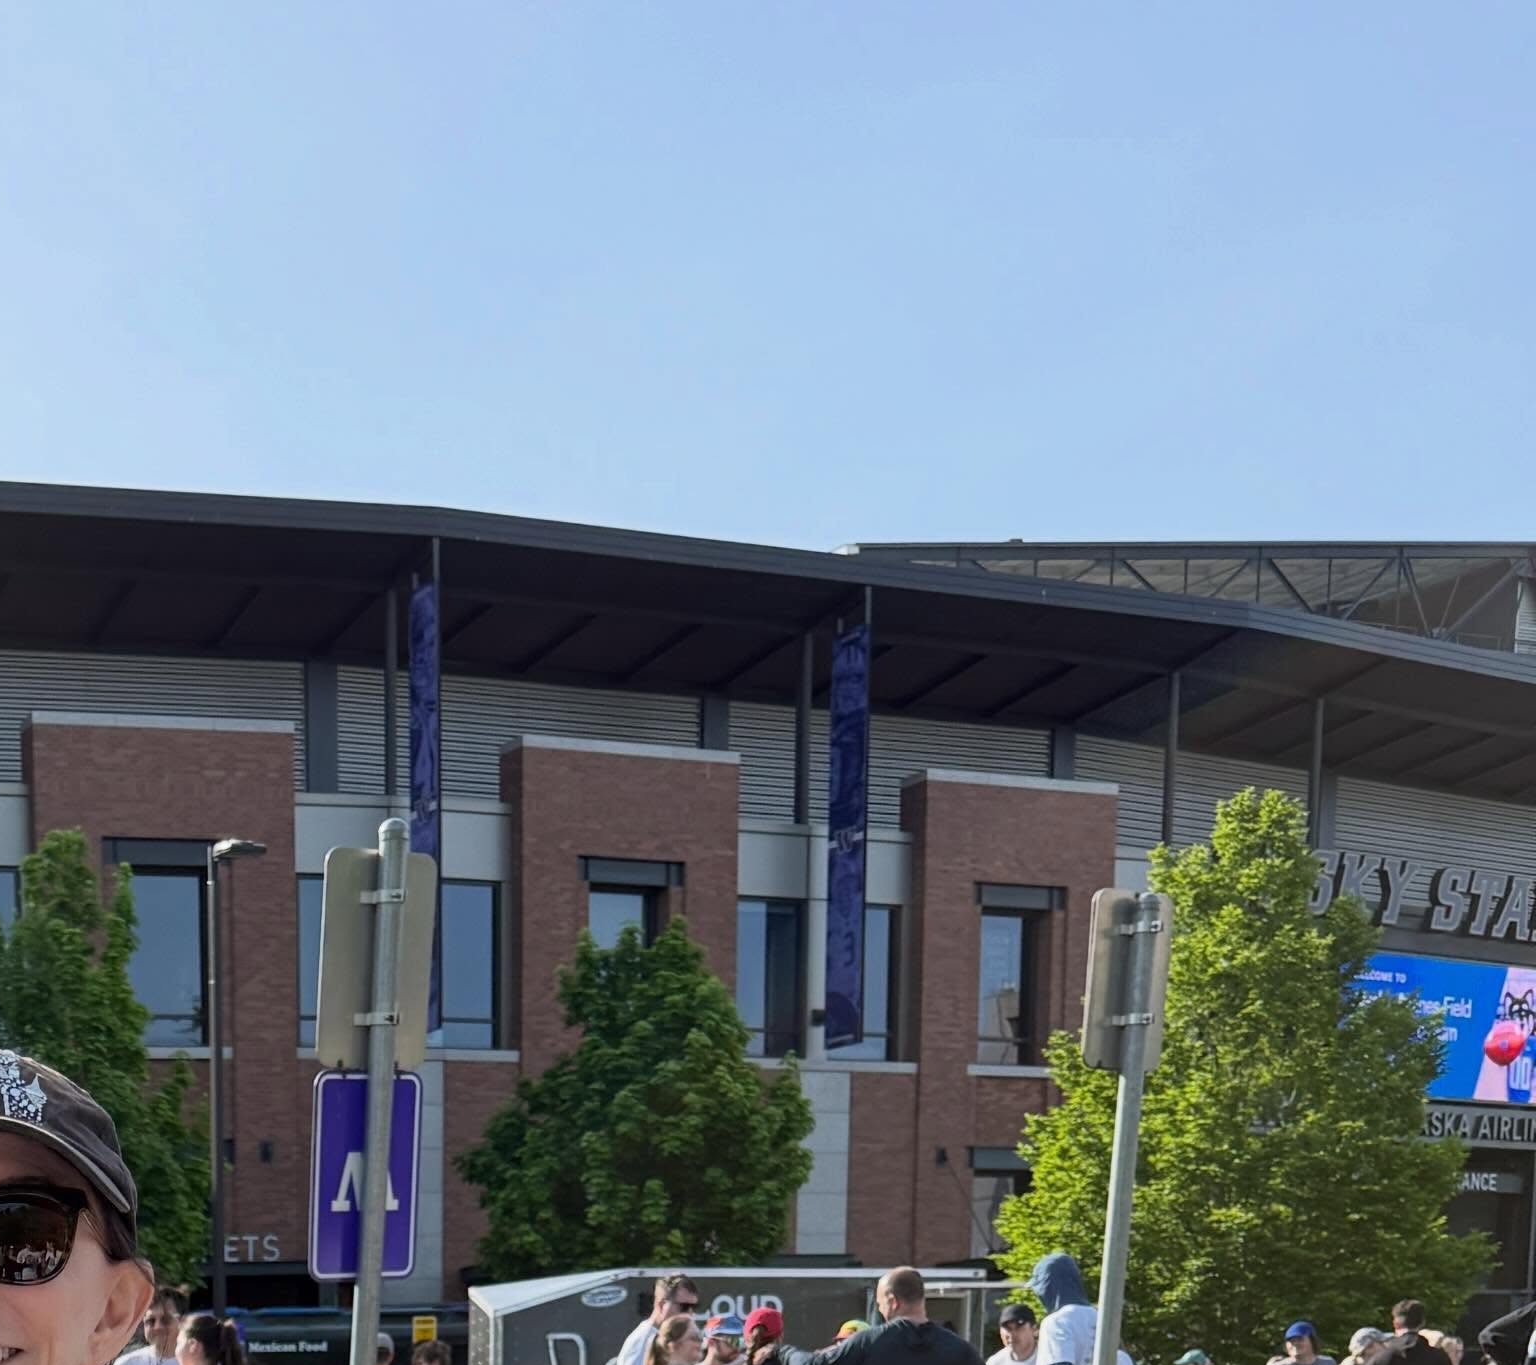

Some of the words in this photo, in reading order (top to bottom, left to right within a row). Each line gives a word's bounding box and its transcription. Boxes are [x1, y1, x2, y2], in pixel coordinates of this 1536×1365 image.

[1431, 866, 1536, 942] STA
[247, 1342, 297, 1353] Mexican
[298, 1341, 328, 1353] Food
